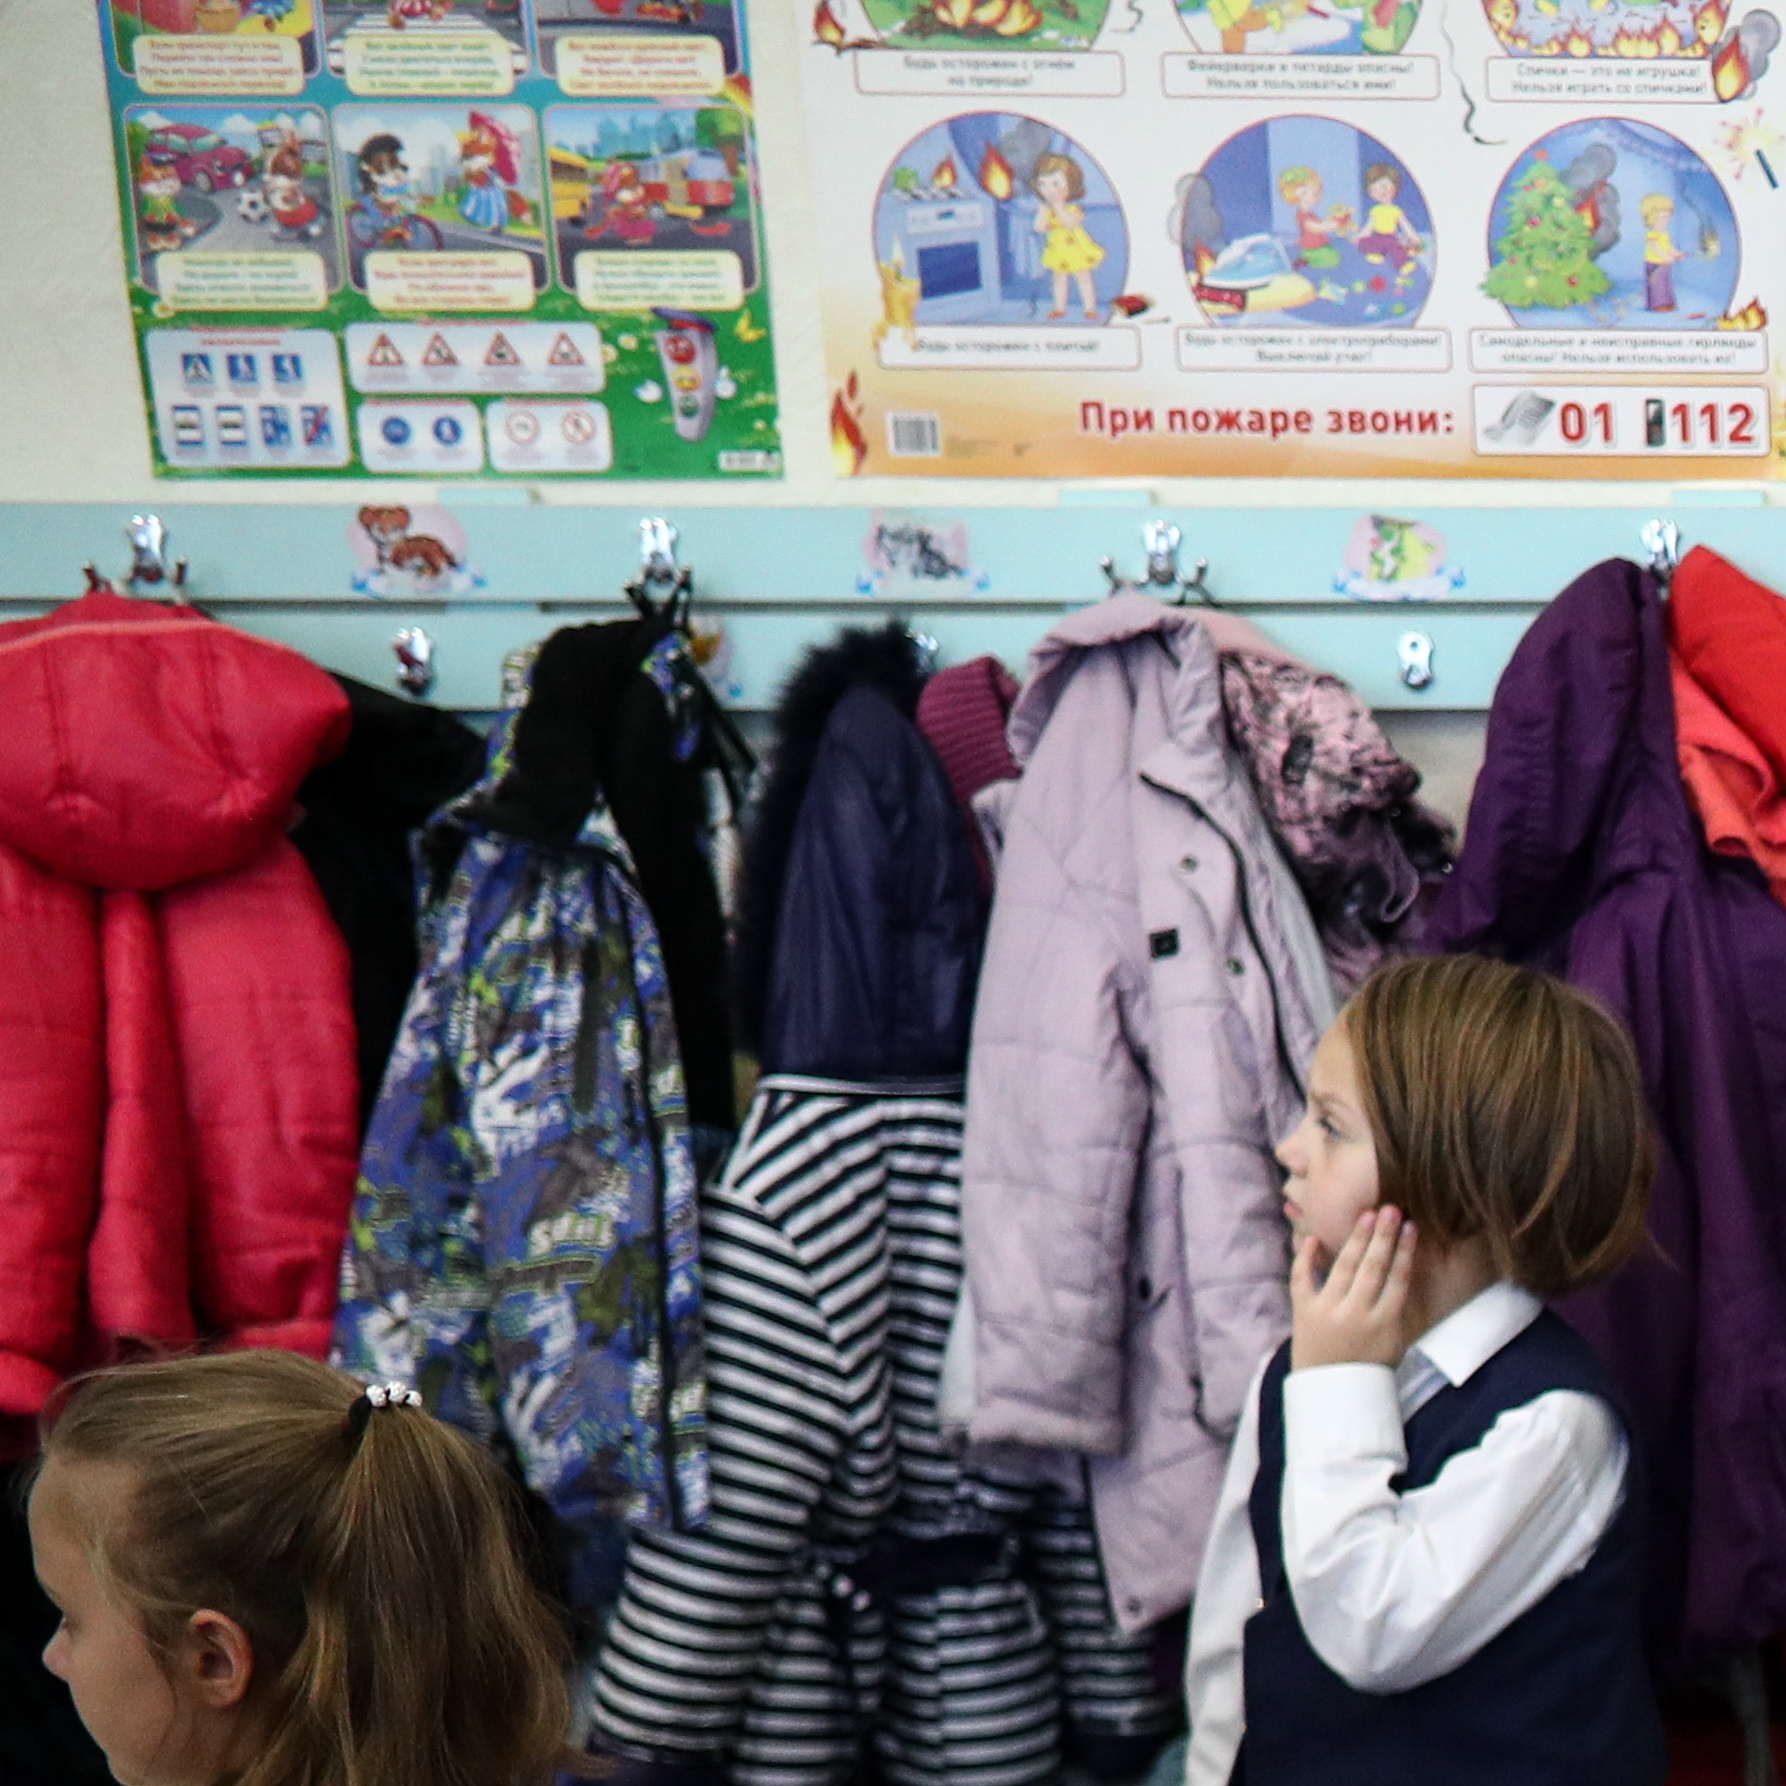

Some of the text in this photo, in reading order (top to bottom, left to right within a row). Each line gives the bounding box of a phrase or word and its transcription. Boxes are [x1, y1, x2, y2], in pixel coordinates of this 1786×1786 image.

[1080, 401, 1455, 442] При пожаре звони:
[1560, 402, 1614, 443] 01
[1671, 402, 1755, 444] 112
